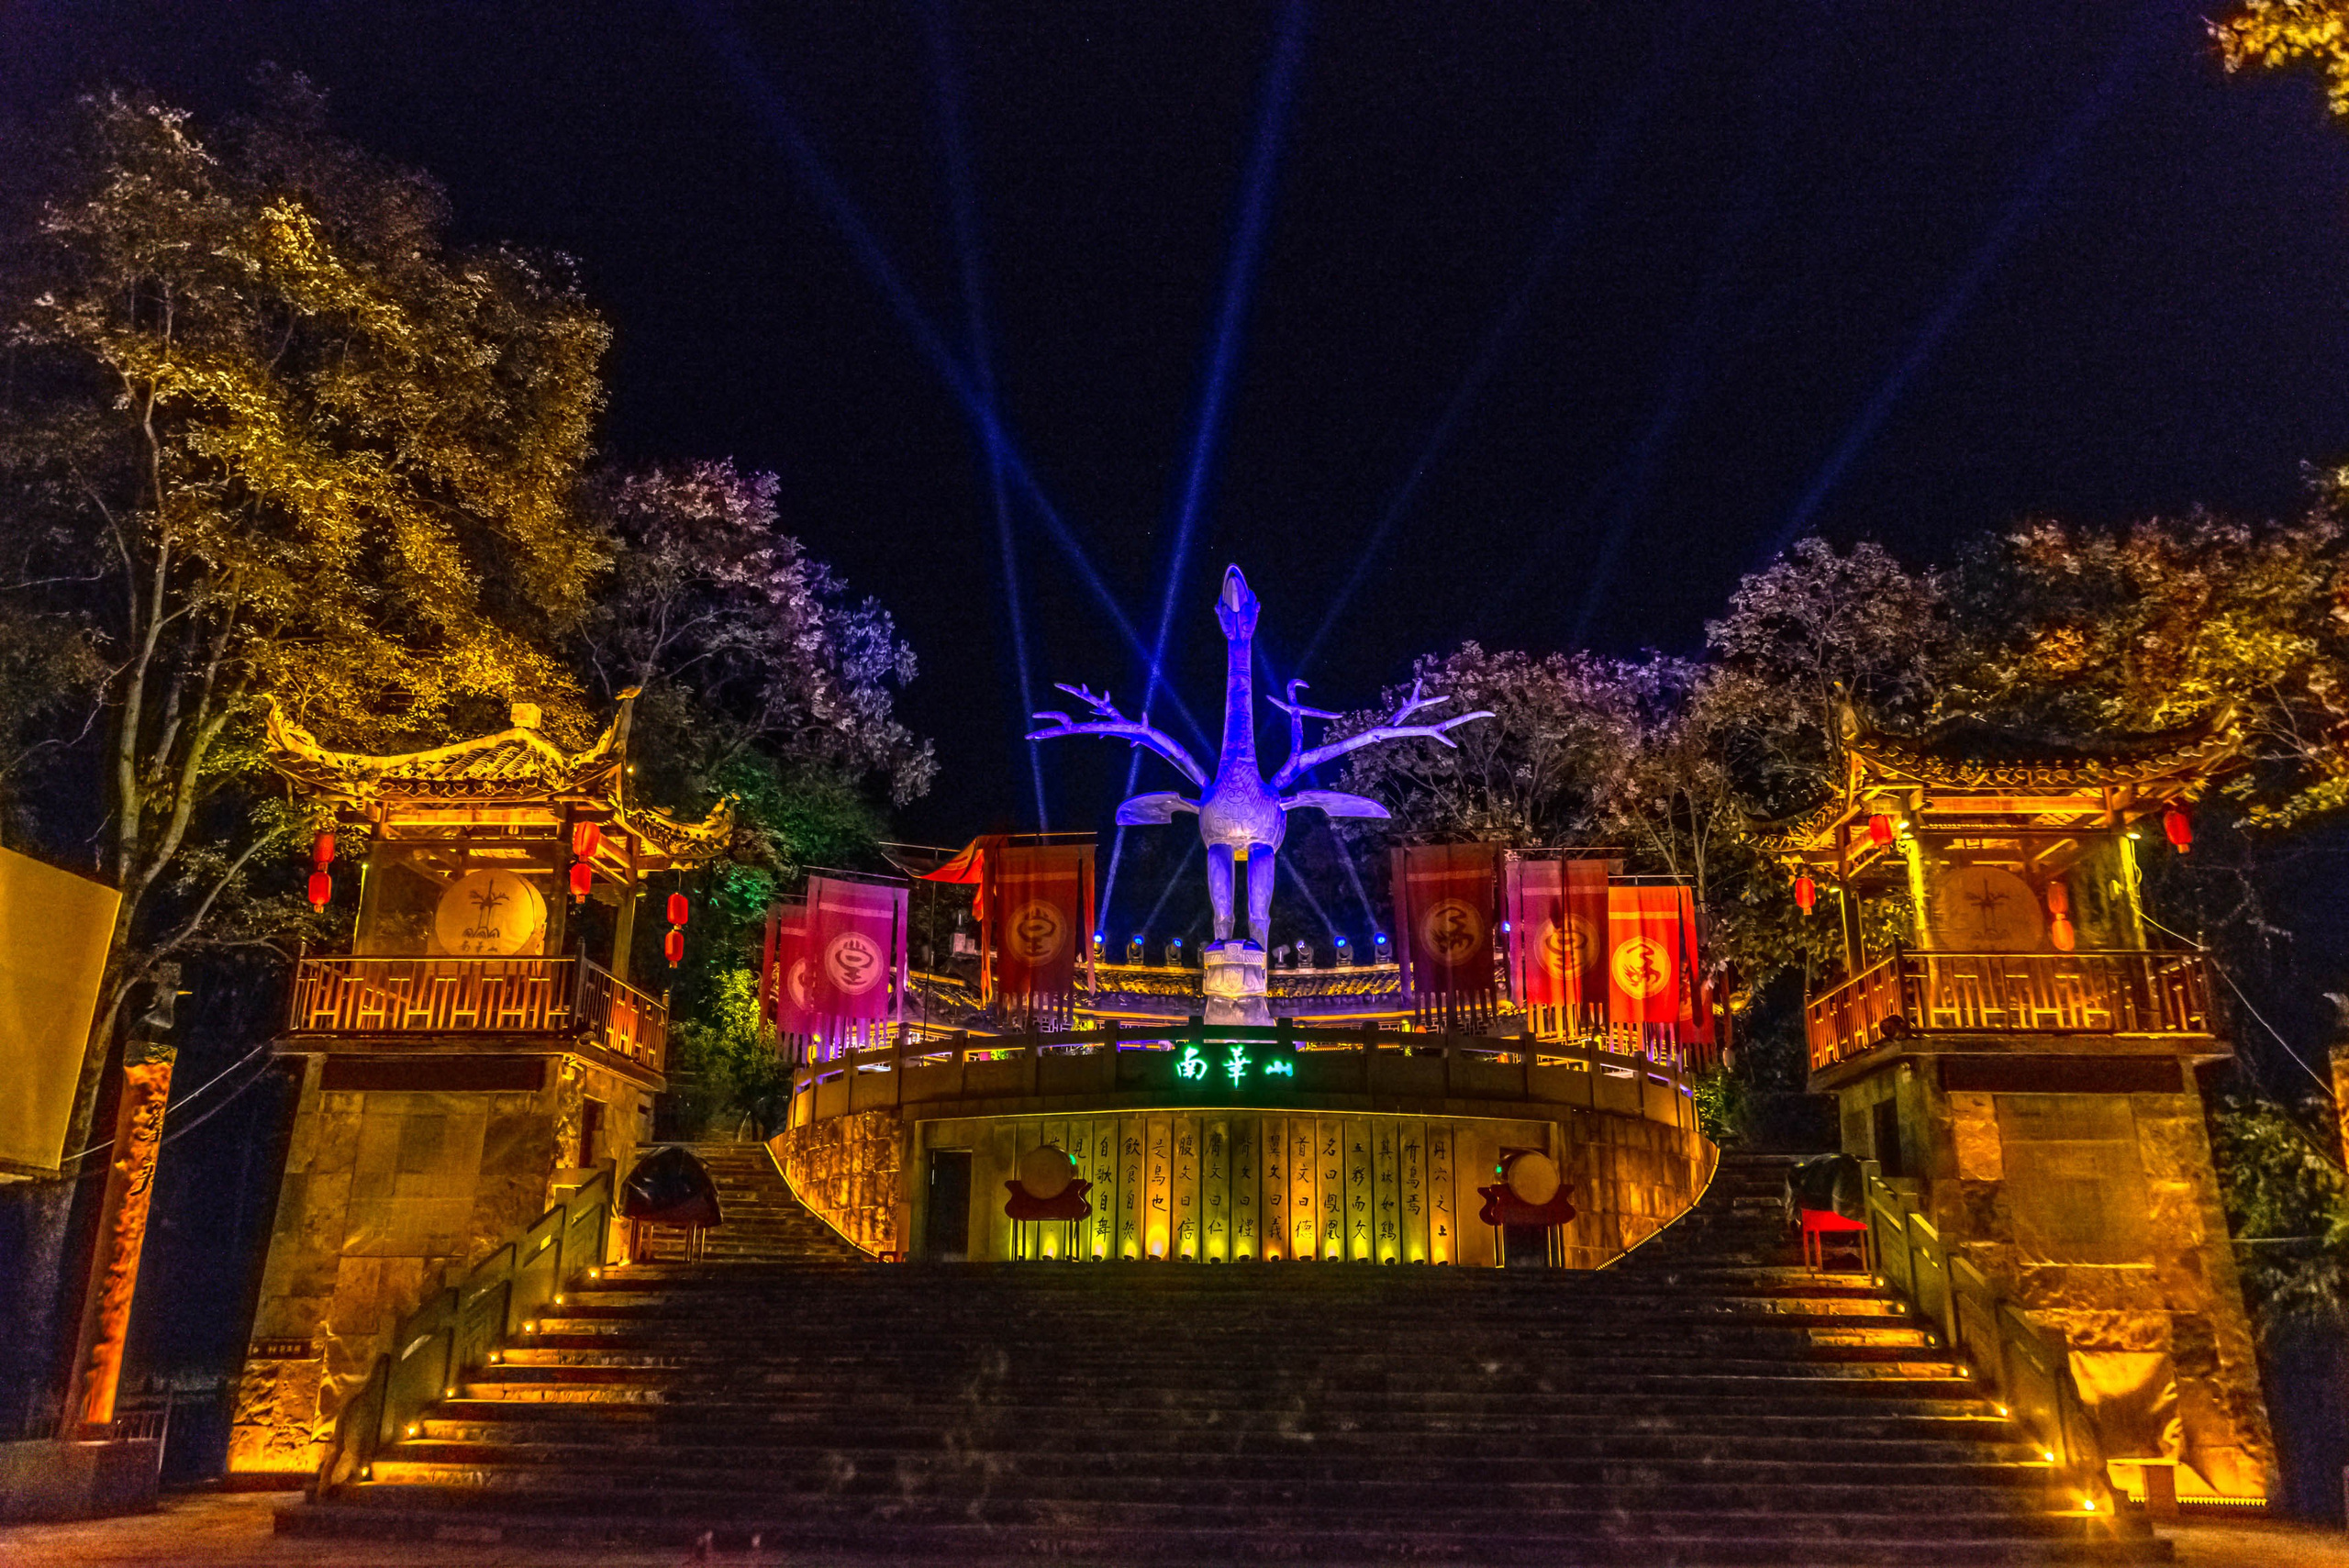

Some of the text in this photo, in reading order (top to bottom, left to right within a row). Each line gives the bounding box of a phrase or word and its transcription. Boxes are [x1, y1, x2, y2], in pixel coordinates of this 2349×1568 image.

[1175, 1045, 1294, 1089] 南華山
[1152, 1138, 1168, 1212] 是鳥也
[1405, 1139, 1421, 1216] 有鳥焉
[1433, 1140, 1450, 1237] 丹穴之上
